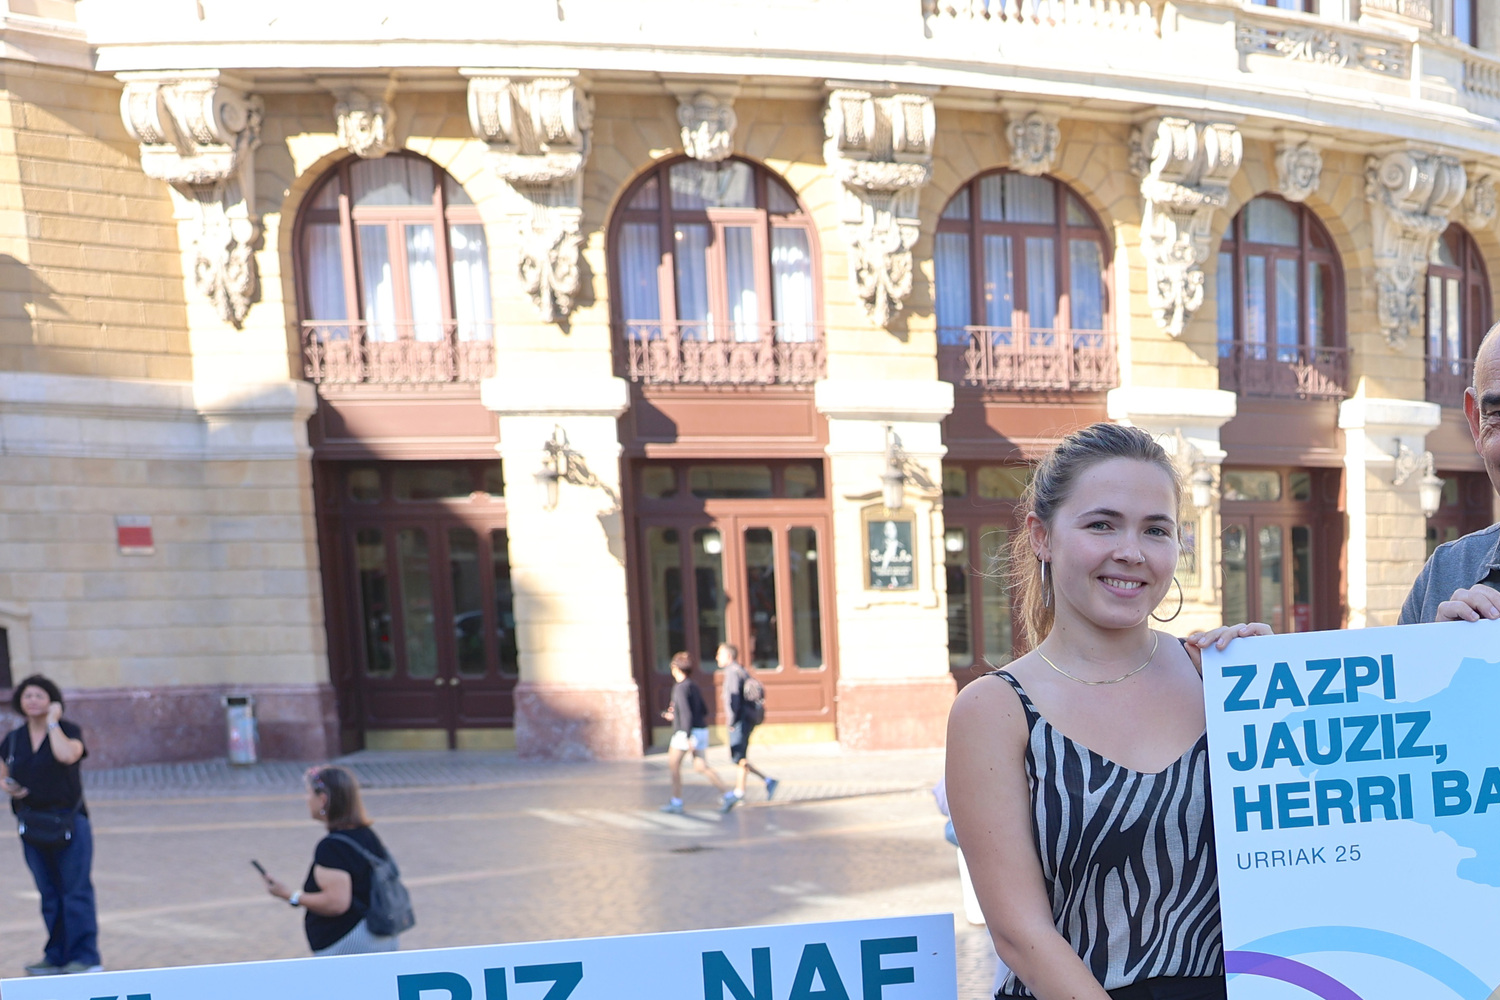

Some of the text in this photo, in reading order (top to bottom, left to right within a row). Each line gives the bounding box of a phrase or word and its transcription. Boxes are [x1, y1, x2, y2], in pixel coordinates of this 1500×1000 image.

[1222, 654, 1396, 712] ZAZPI
[1227, 711, 1447, 771] JAUZIZ,
[1233, 774, 1414, 832] HERRI
[1236, 844, 1361, 870] URRIAK 25
